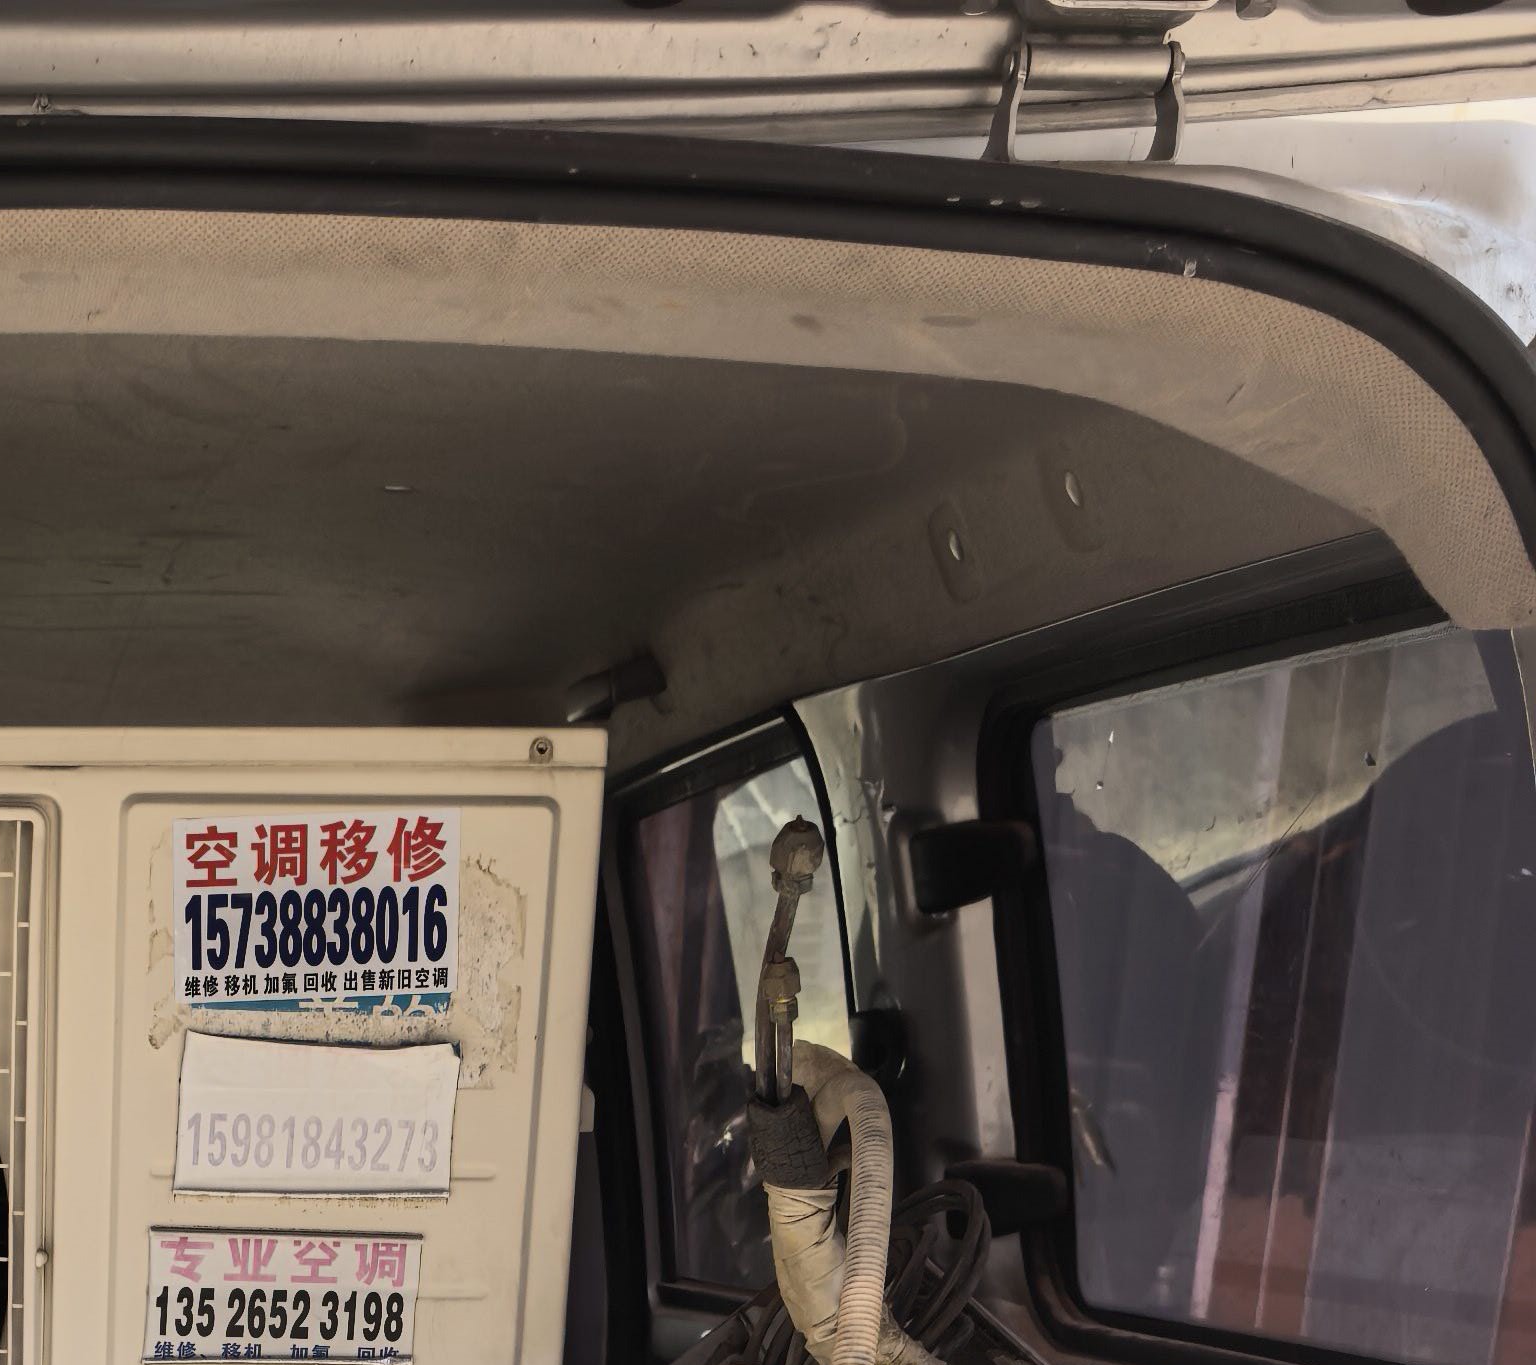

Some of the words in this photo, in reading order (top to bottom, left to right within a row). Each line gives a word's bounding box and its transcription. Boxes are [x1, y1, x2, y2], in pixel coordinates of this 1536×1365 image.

[186, 815, 447, 887] 空调移修
[185, 884, 448, 970] 15738838016
[187, 1112, 439, 1173] 15981843273
[160, 1236, 407, 1287] 专业空调
[156, 1286, 214, 1337] 135
[225, 1289, 311, 1339] 2652
[320, 1291, 403, 1342] 3198
